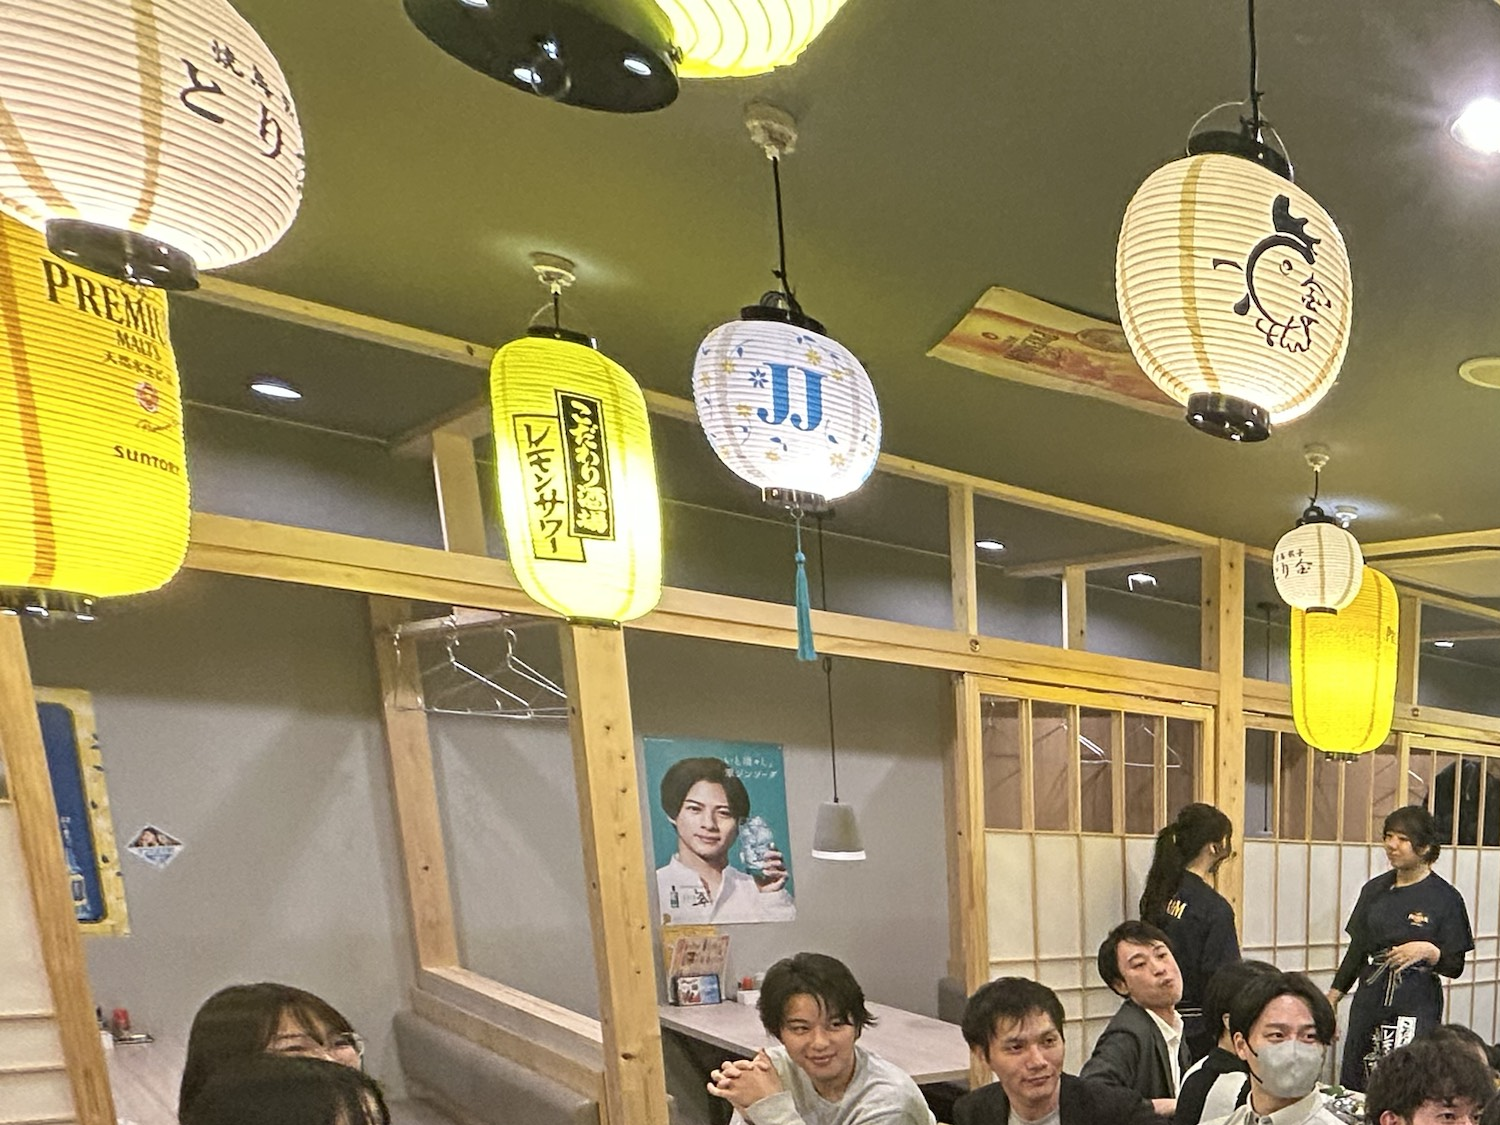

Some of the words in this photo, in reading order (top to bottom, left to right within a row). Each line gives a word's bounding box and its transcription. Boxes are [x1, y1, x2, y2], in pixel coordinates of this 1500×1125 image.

[756, 362, 828, 431] JJ
[524, 423, 565, 554] レモンサワー
[568, 399, 609, 534] こだわり酒場
